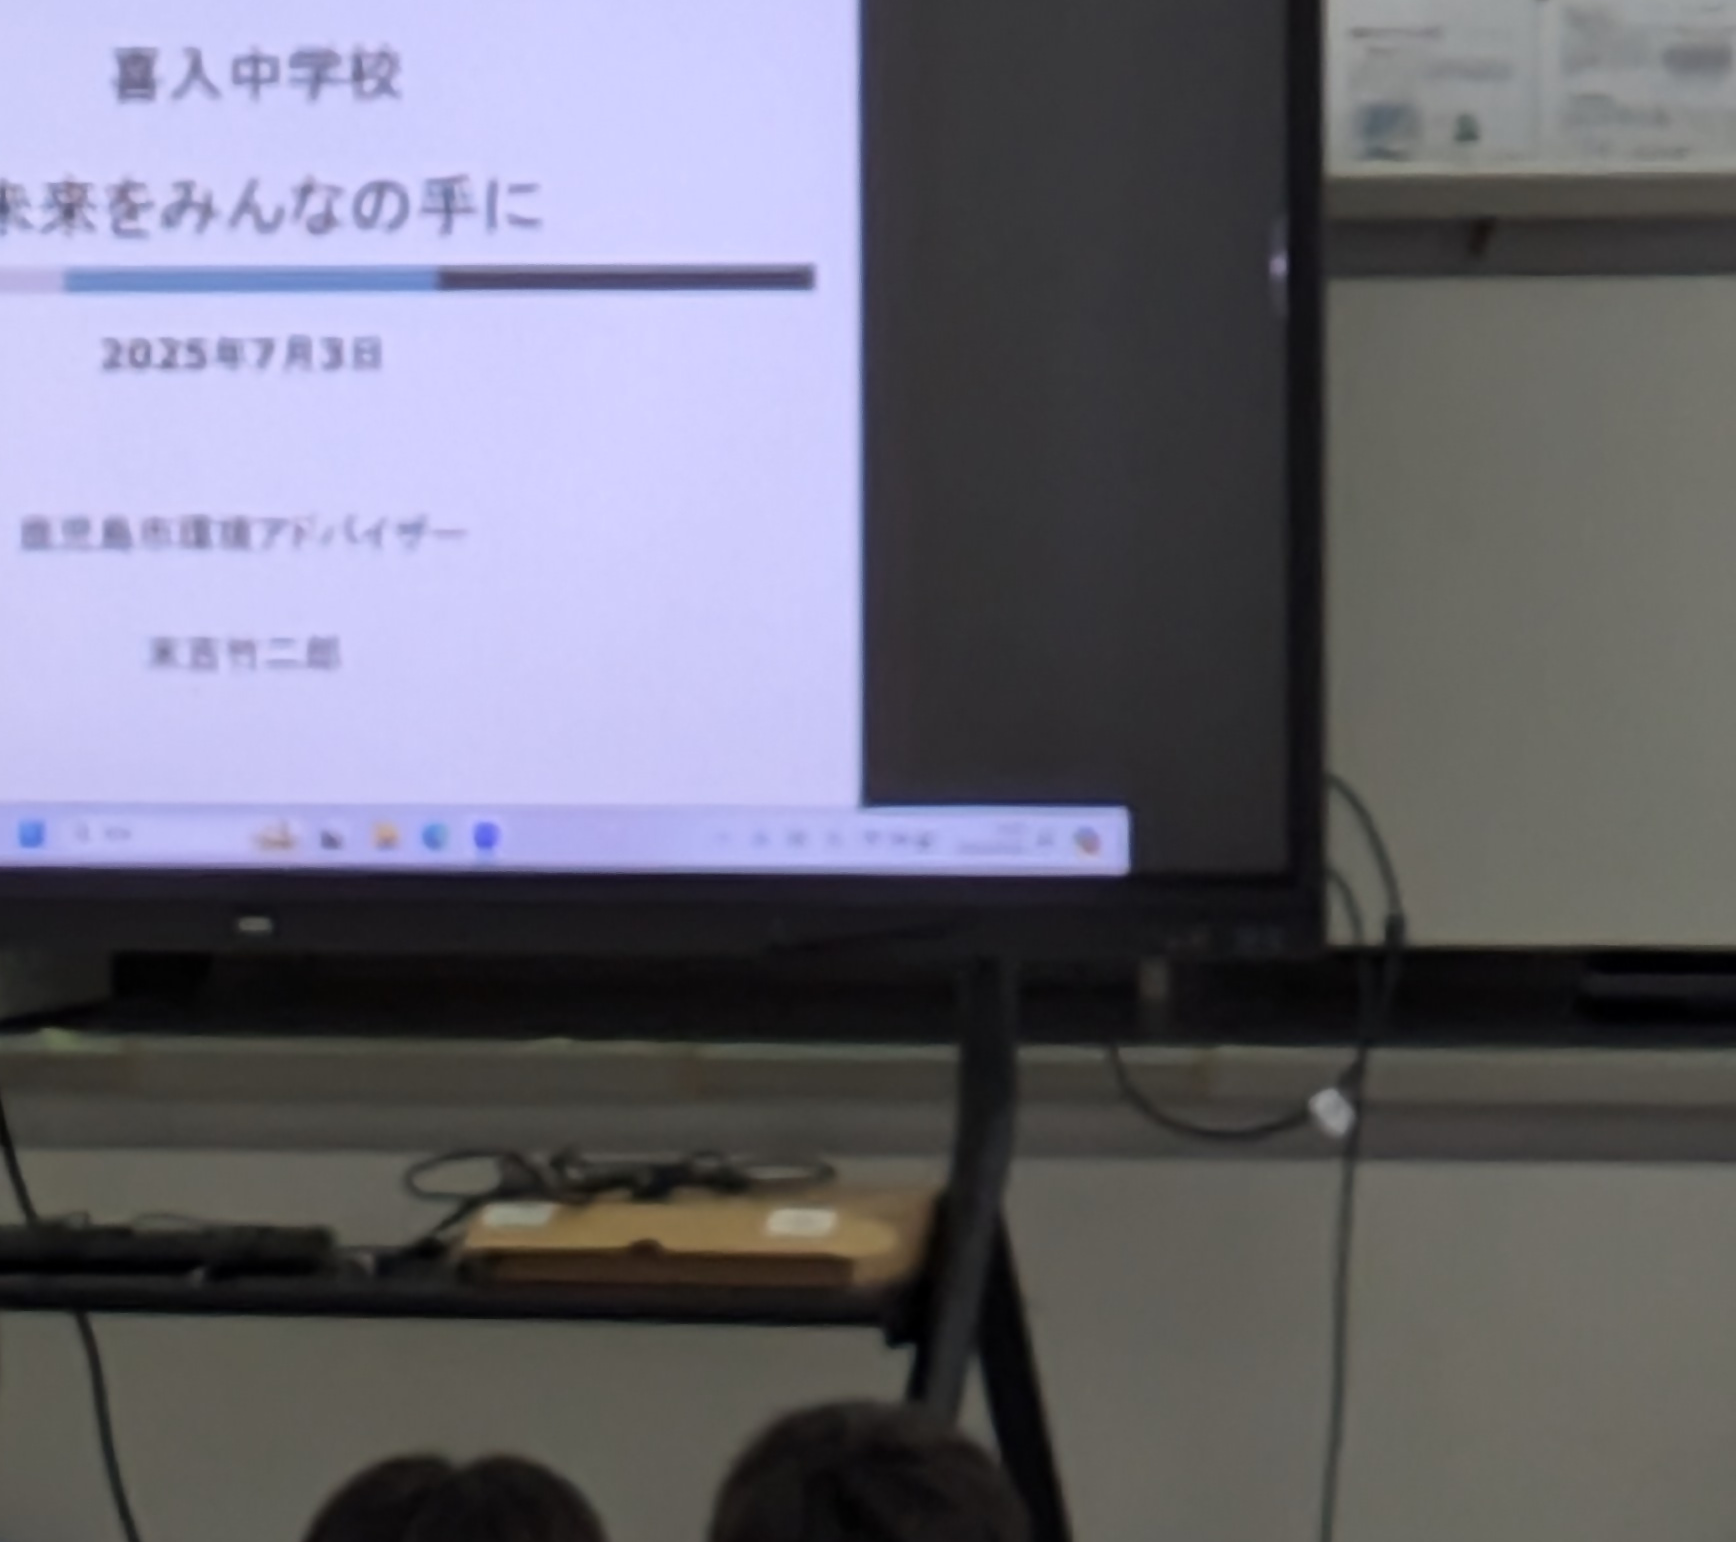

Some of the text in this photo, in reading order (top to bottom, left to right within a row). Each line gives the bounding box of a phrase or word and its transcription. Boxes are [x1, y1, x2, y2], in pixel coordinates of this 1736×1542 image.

[114, 46, 401, 102] 喜入中学校
[100, 335, 382, 371] 2025年7月3日
